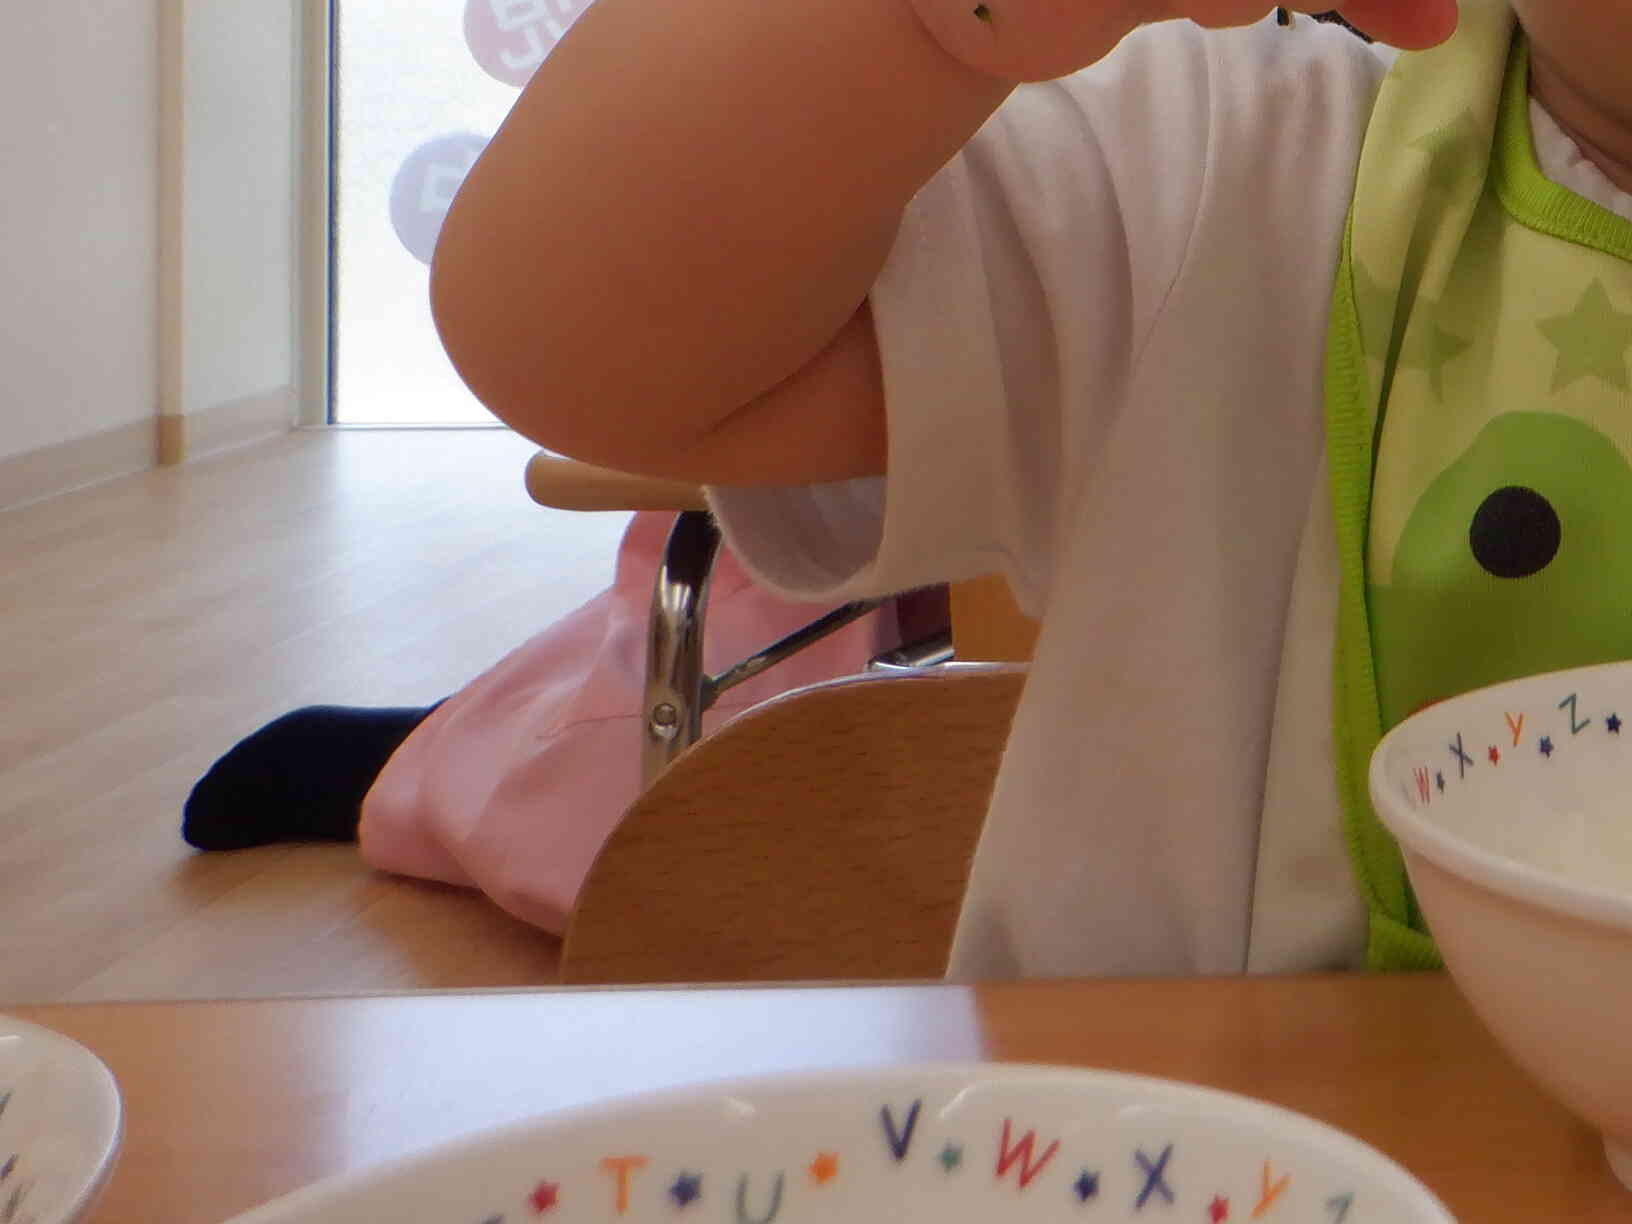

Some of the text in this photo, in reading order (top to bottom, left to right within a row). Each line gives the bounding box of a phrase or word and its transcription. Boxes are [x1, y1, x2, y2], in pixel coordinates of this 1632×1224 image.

[1449, 732, 1474, 780] X
[1504, 711, 1524, 747] Y
[1557, 692, 1591, 735] Z
[598, 1154, 651, 1214] T
[735, 1170, 785, 1224] U
[880, 1096, 922, 1162] V
[995, 1116, 1060, 1189] W
[1134, 1142, 1174, 1210] X
[1249, 1154, 1292, 1221] Y
